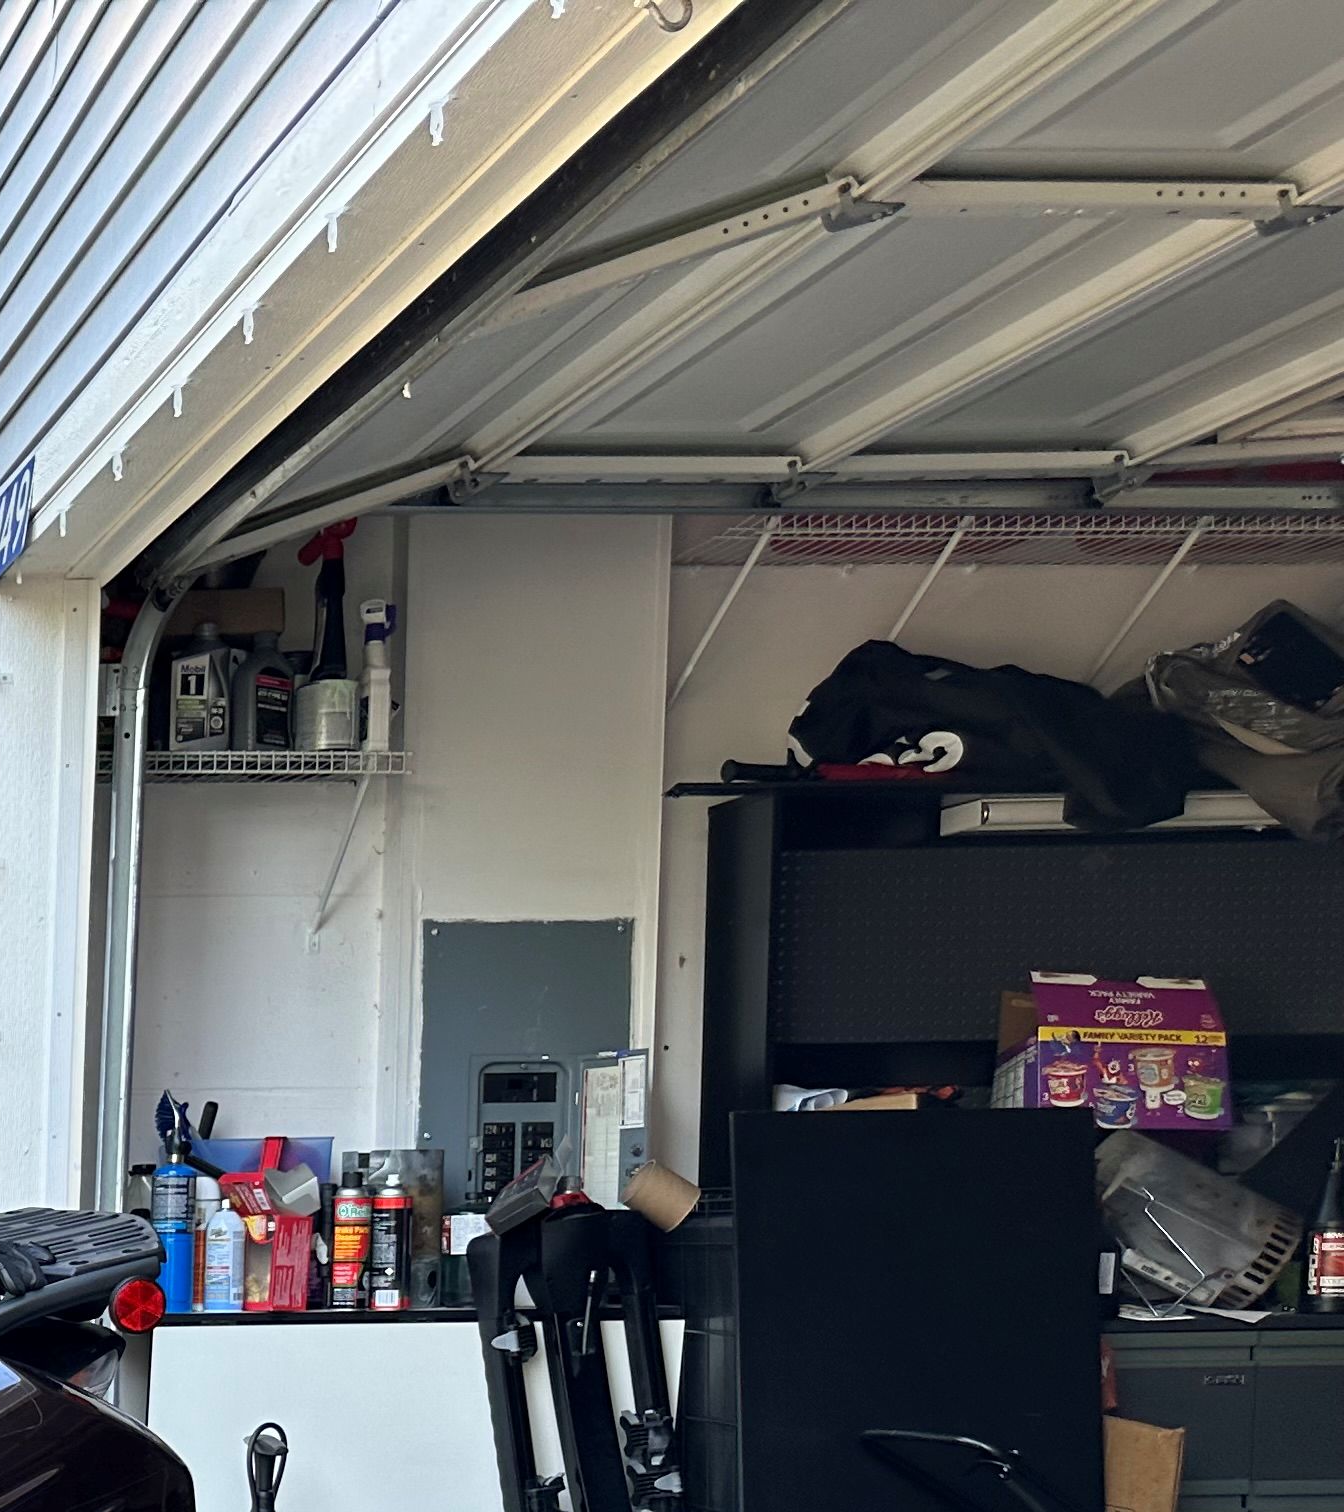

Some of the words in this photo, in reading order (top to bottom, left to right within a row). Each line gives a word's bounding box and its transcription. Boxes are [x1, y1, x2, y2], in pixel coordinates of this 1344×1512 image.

[180, 664, 206, 673] Mobil
[188, 675, 197, 695] 1
[1094, 1005, 1163, 1027] Kellogg's
[1083, 1031, 1115, 1041] FAMILY
[1117, 1032, 1156, 1041] VARIETY
[1158, 1033, 1183, 1043] PACK
[1194, 1034, 1209, 1044] 12
